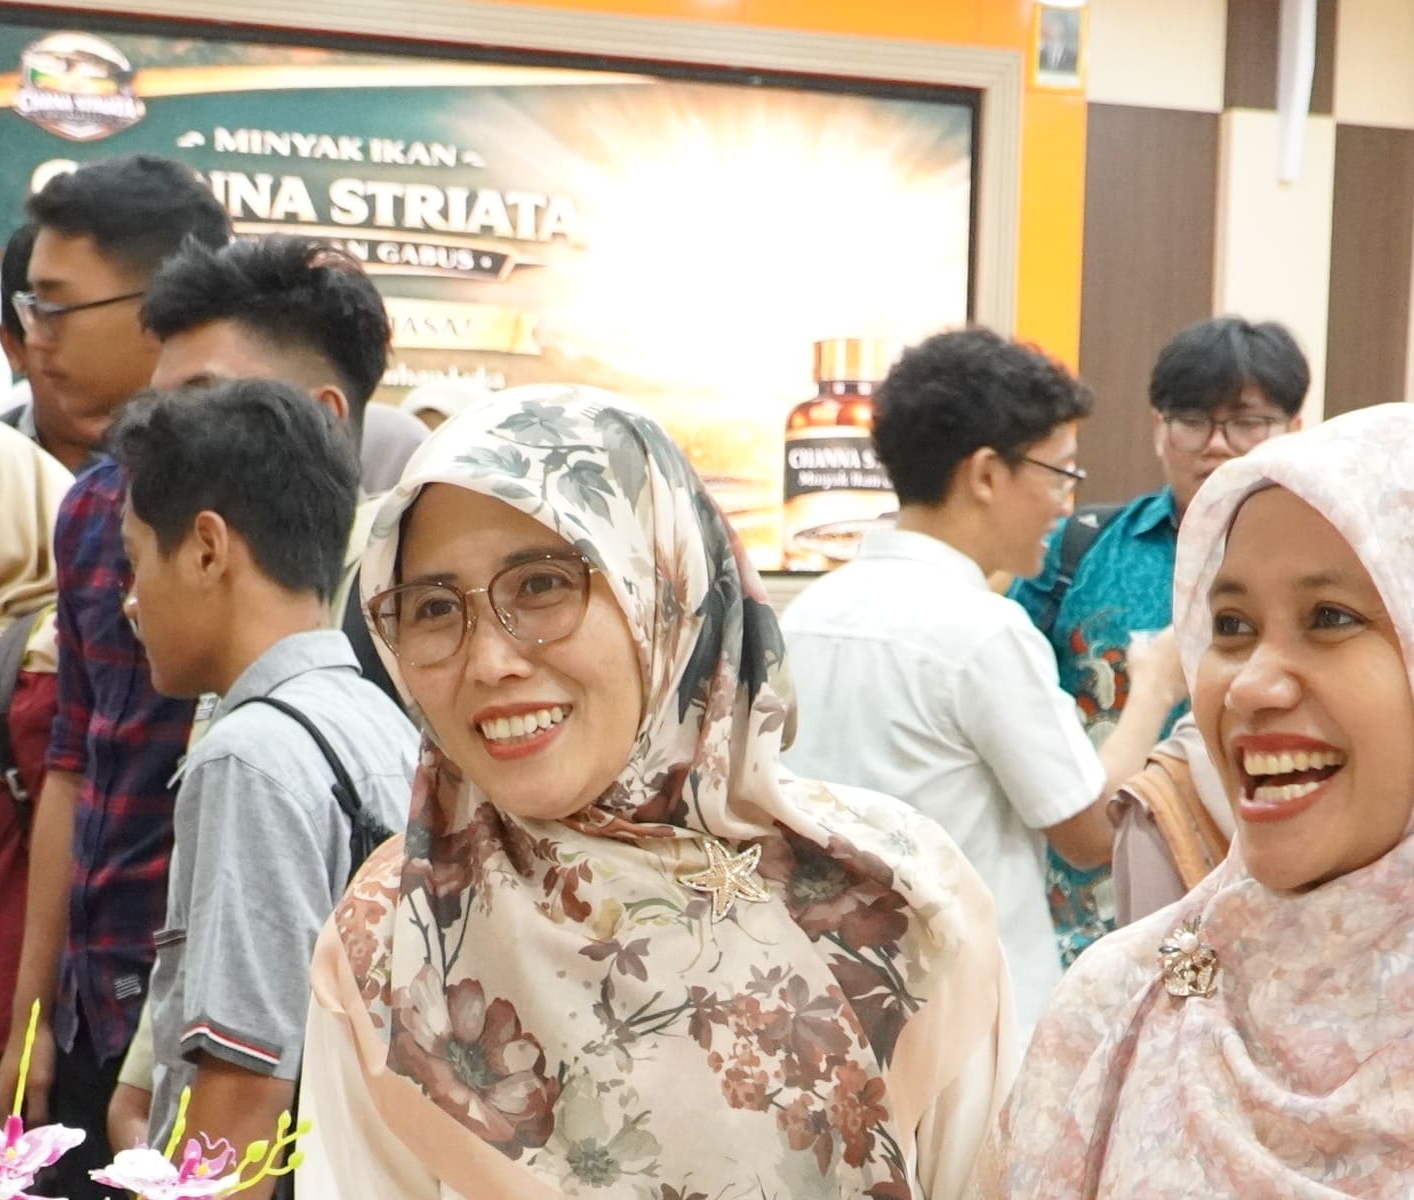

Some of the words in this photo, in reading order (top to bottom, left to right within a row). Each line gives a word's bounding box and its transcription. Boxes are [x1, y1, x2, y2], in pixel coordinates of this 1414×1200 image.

[213, 128, 364, 161] MINYAK
[370, 138, 457, 167] IKAN
[329, 178, 585, 242] STRIATA
[377, 241, 474, 270] GABUS
